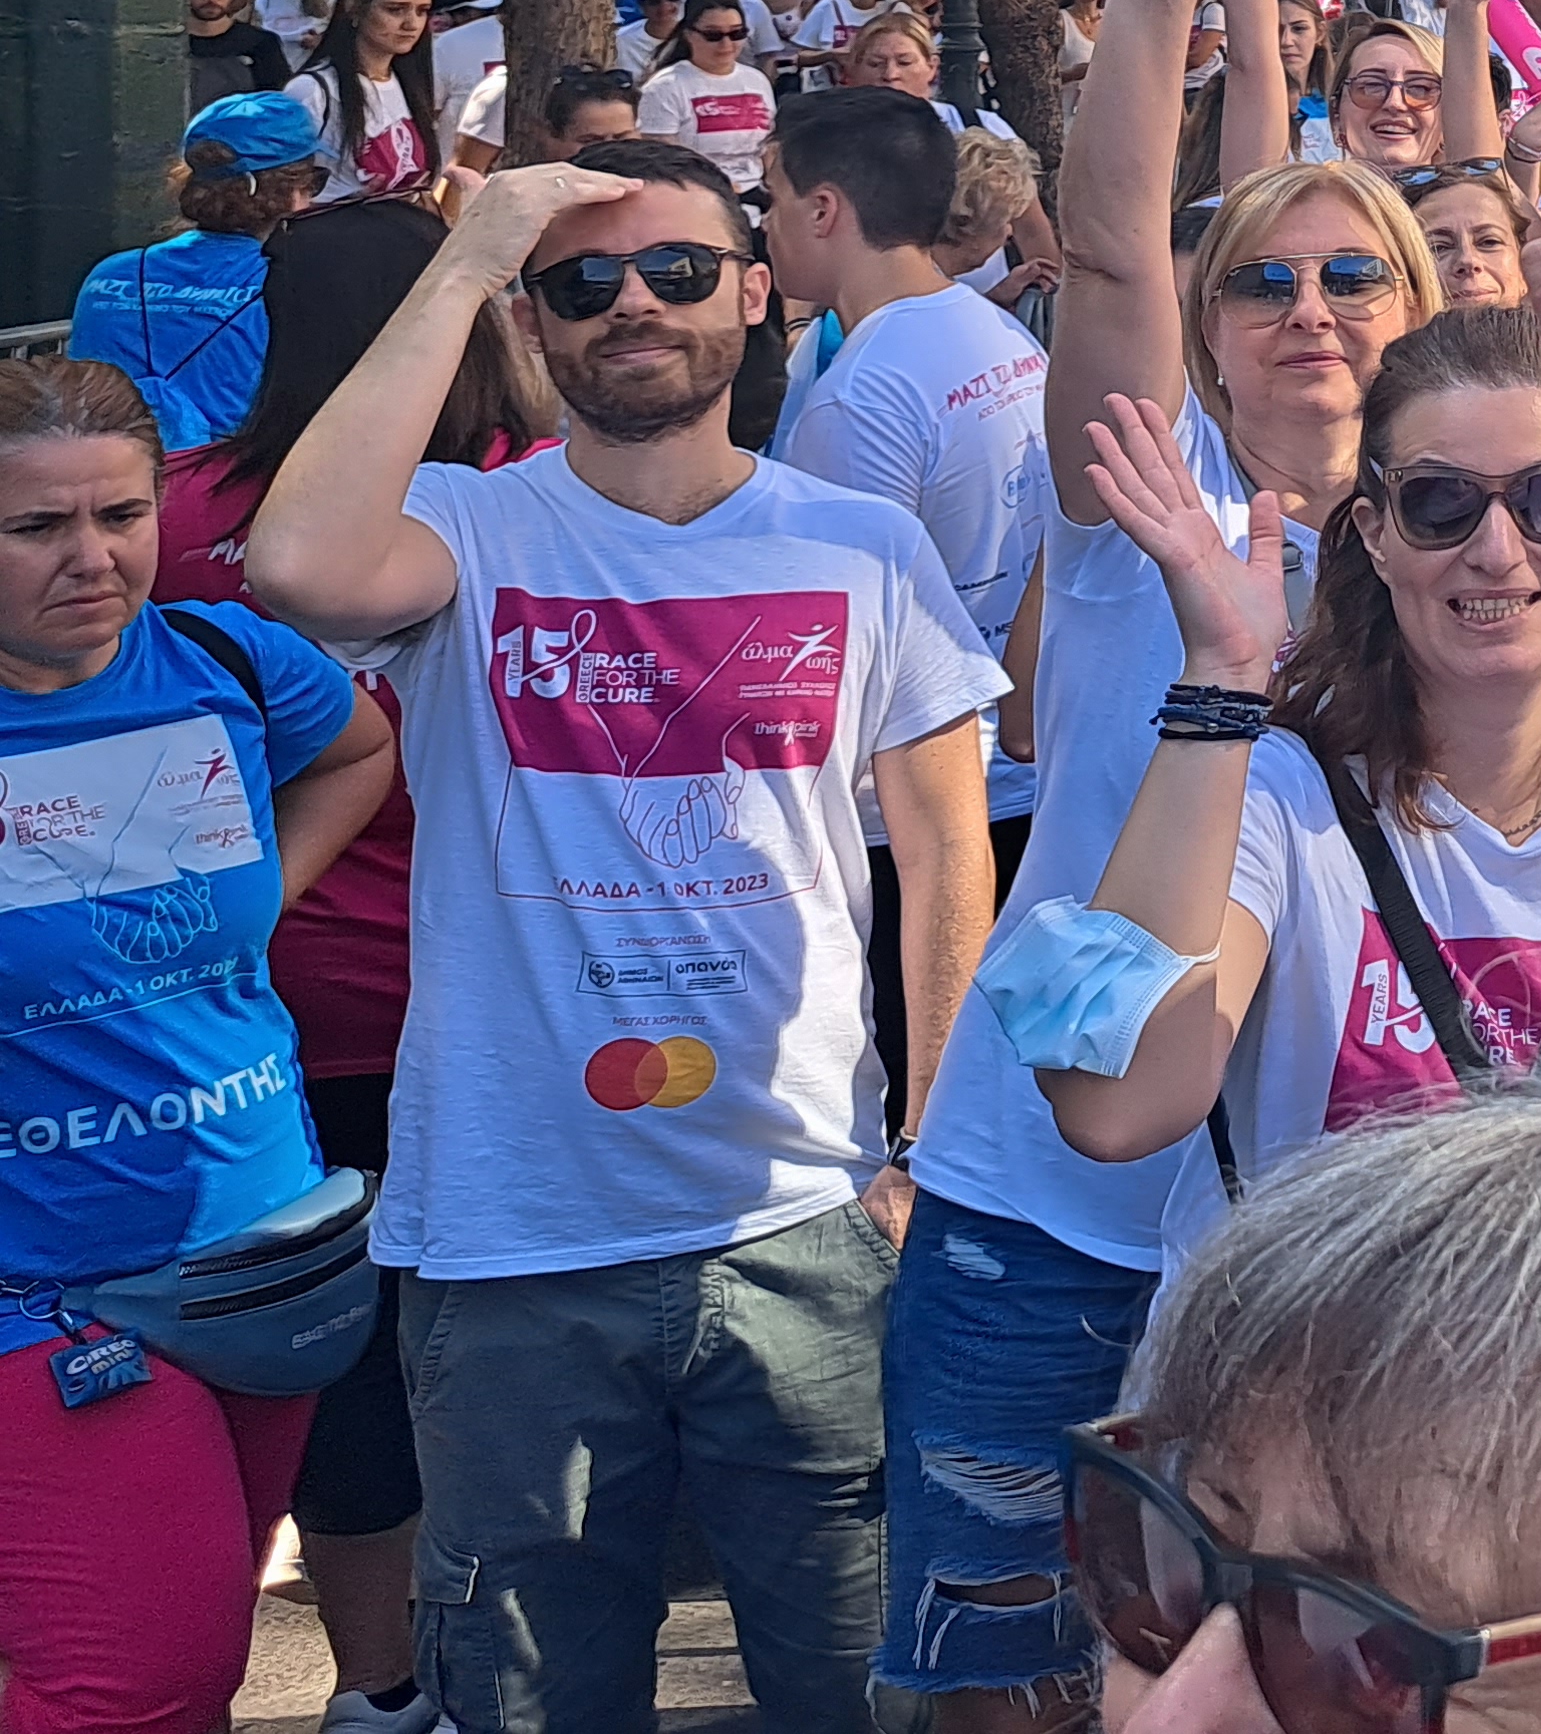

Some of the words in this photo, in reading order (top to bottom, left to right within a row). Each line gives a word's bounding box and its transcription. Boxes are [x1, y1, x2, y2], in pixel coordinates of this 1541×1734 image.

[498, 625, 571, 699] 15
[506, 640, 522, 682] YEARS
[595, 652, 657, 668] RACE
[577, 652, 593, 703] GREECE
[593, 670, 637, 686] FOR
[637, 668, 680, 685] THE
[20, 794, 82, 817] RACE
[724, 873, 769, 895] 2023
[24, 987, 123, 1020] ΕΛΛΑΔΑ
[1370, 972, 1388, 1024] YEARS
